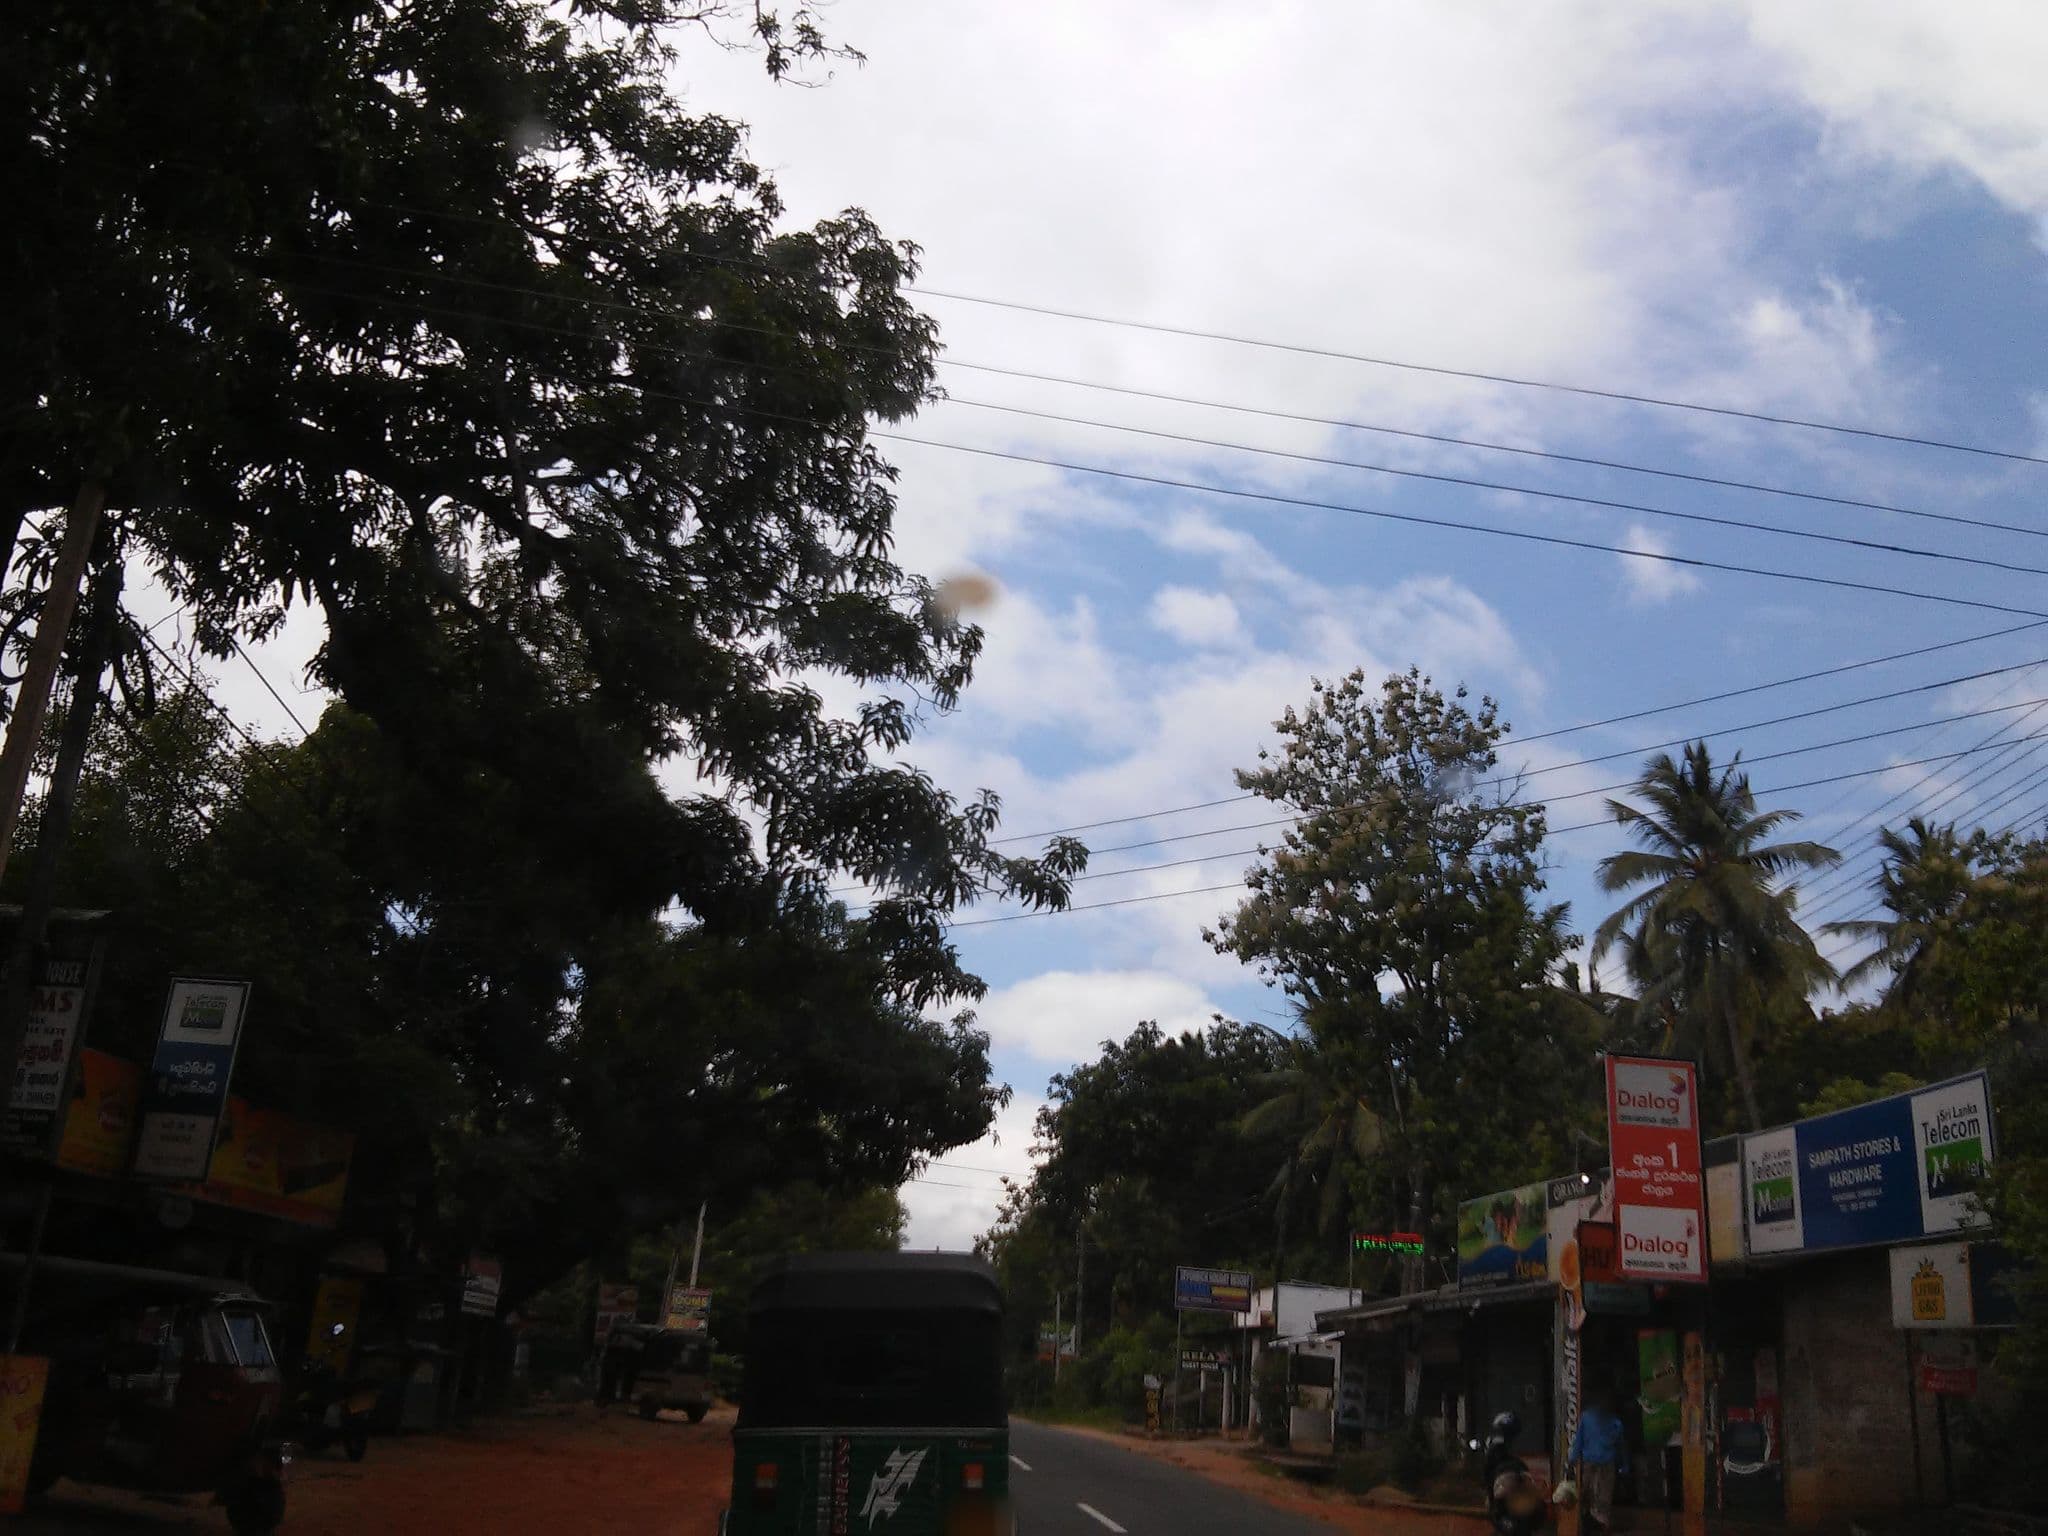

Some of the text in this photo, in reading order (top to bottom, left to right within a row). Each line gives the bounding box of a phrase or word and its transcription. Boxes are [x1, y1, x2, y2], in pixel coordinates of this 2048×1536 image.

[1618, 1089, 1680, 1114] Dialog
[1939, 1103, 1978, 1122] Sri Lanka
[1921, 1115, 1981, 1146] Telecom
[1667, 1141, 1679, 1168] 1
[1808, 1144, 1852, 1169] SAMPATH
[1852, 1137, 1893, 1160] STORES
[1828, 1164, 1882, 1188] HARDWARE
[1624, 1233, 1688, 1257] Dialog
